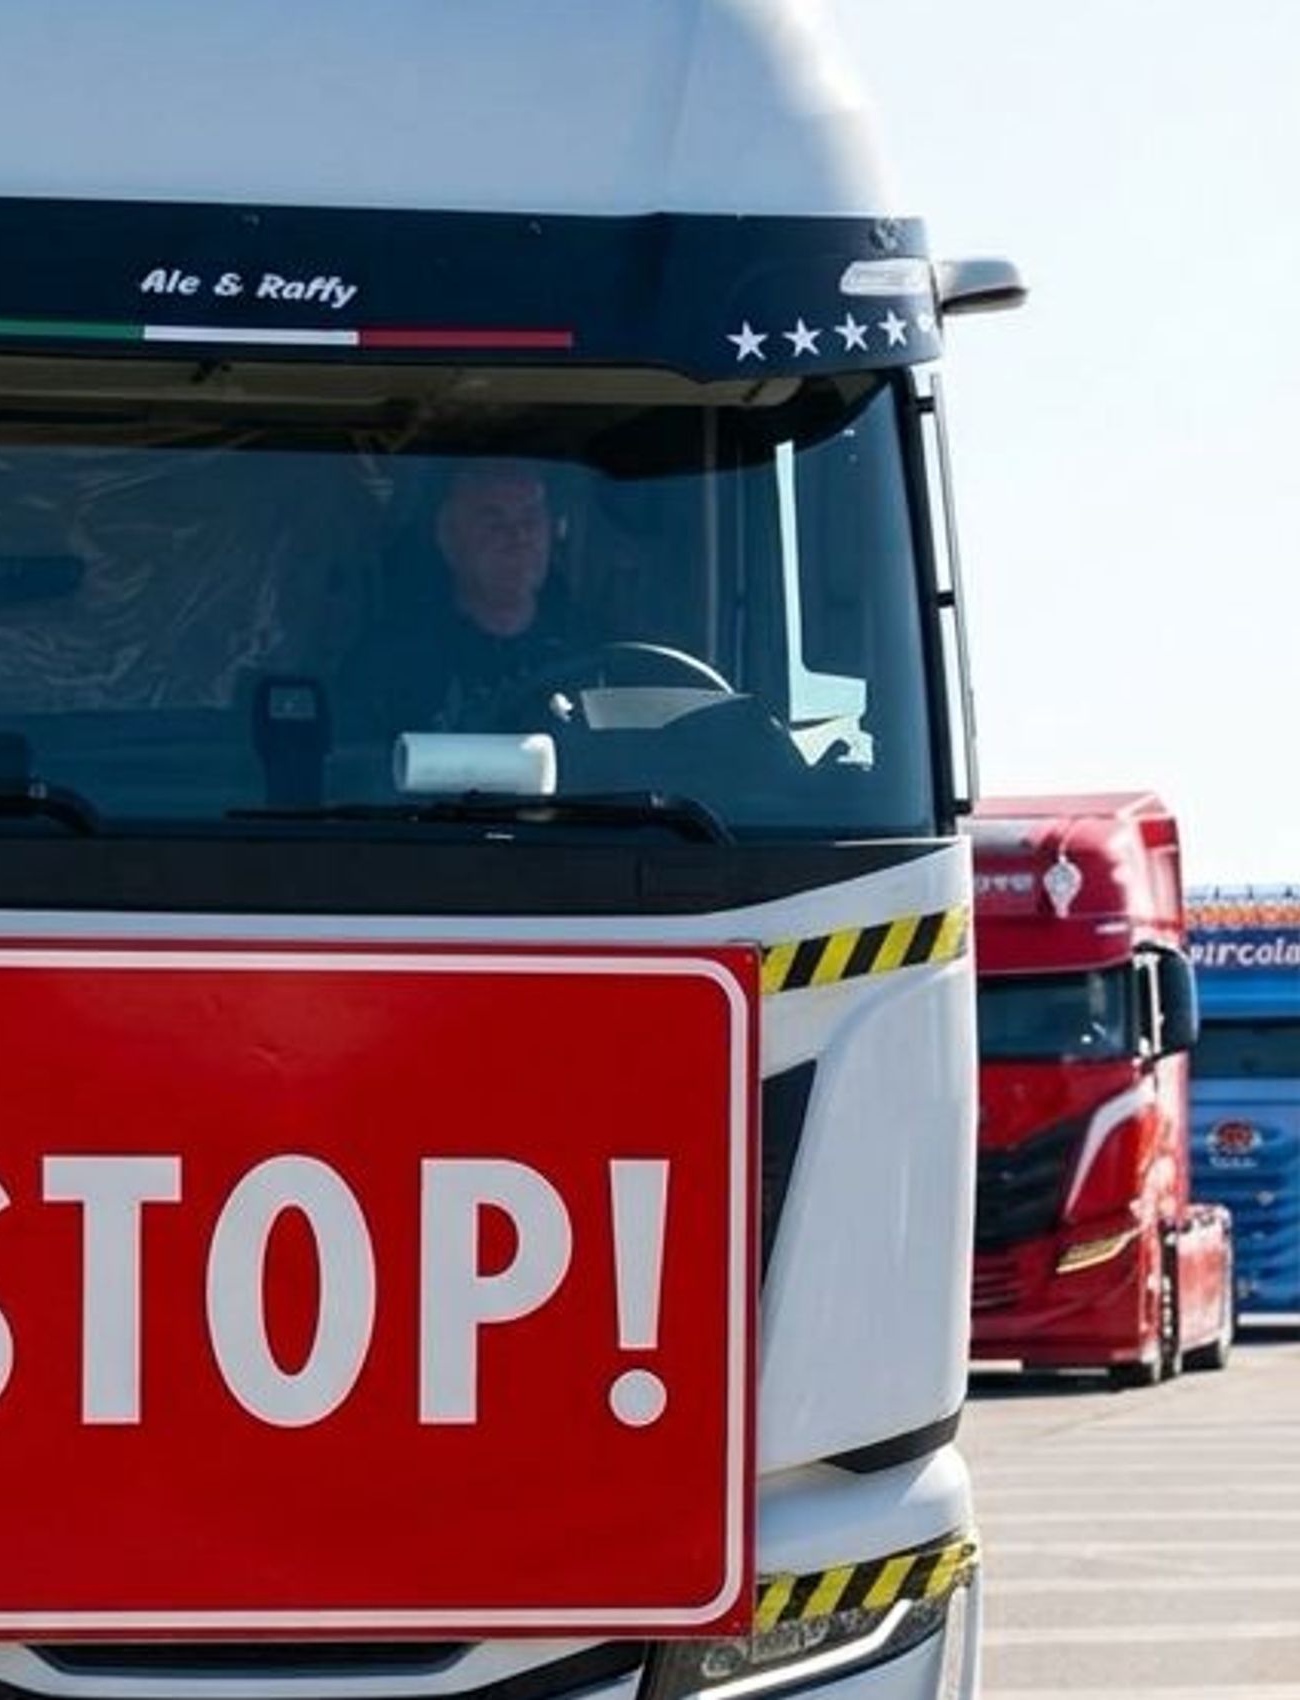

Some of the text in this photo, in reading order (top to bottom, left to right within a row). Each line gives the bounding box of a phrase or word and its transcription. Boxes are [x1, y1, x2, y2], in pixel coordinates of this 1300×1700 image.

[141, 269, 357, 308] Ale & Raffy
